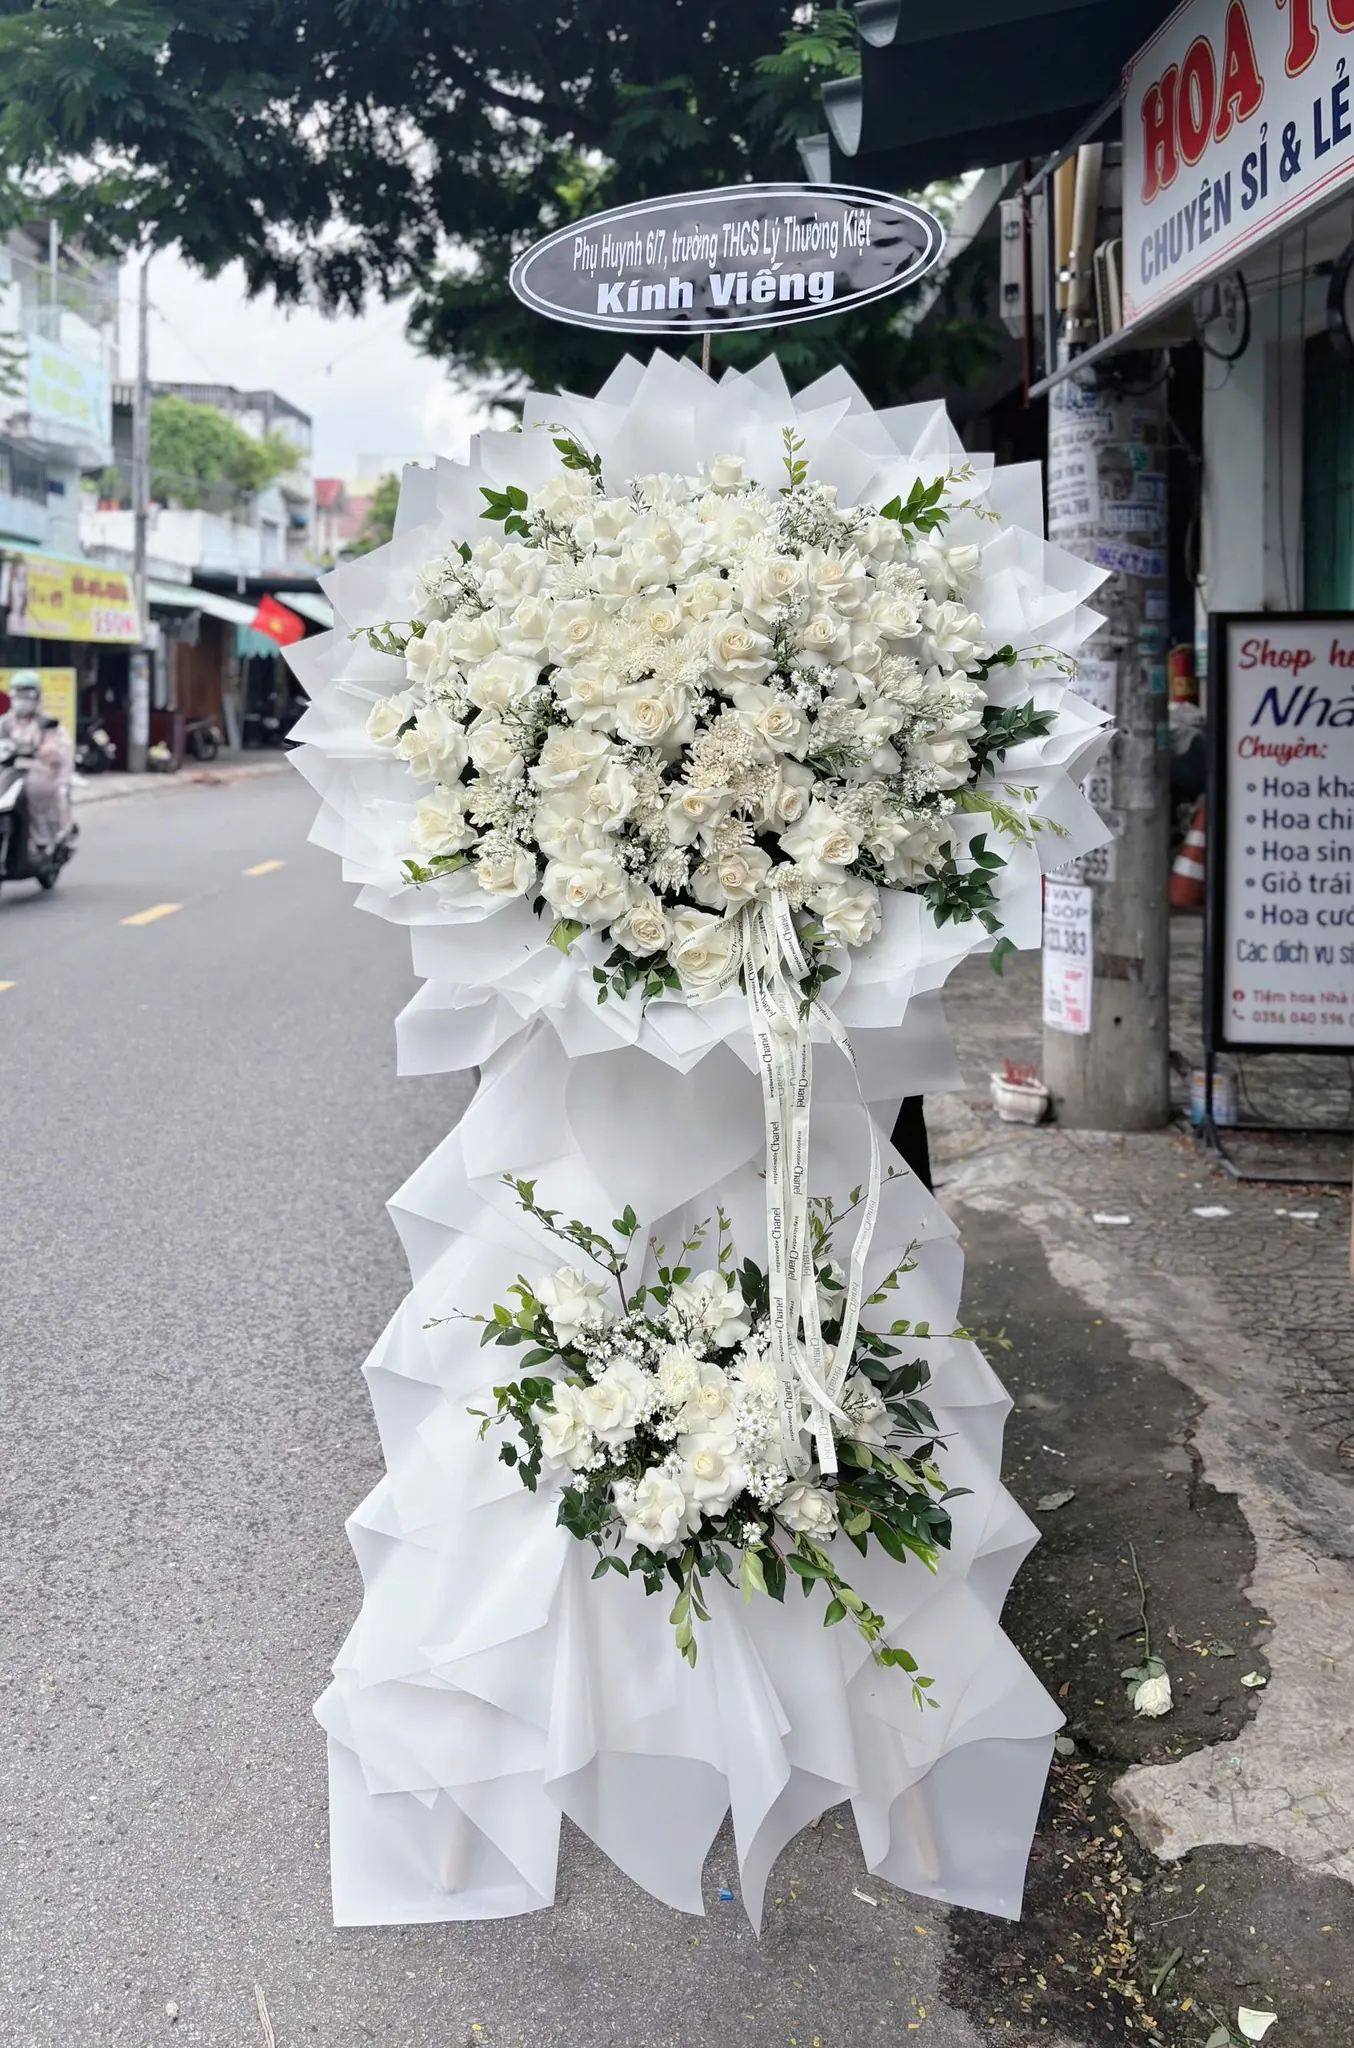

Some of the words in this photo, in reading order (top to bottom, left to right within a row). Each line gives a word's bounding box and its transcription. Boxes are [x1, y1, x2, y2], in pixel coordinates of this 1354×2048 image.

[1141, 0, 1264, 205] HOA
[1141, 171, 1231, 285] CHUYÊN
[1241, 122, 1268, 211] SỈ
[1280, 121, 1301, 182] &
[1314, 57, 1352, 160] LẺ
[573, 235, 599, 278] Phụ
[601, 231, 642, 277] Huynh
[646, 228, 668, 270] 6/7,
[672, 223, 718, 268] trường
[722, 219, 760, 258] THCS
[763, 216, 781, 264] Lý
[784, 211, 839, 259] Thường
[843, 208, 872, 257] Kiệt
[597, 276, 694, 314] Kính
[709, 262, 835, 307] Viếng
[1239, 638, 1316, 677] Shop
[1239, 735, 1327, 767] Chuyên:
[1262, 776, 1310, 798] Hoa
[1262, 808, 1310, 830] Hoa
[1262, 840, 1309, 862] Hoa
[1261, 870, 1302, 894] Giỏ
[1309, 872, 1351, 894] trái
[779, 913, 793, 942] Chanel
[1261, 903, 1309, 925] Hoa
[746, 951, 758, 982] Chanel
[1237, 938, 1268, 963] Các
[1314, 945, 1334, 967] vụ
[758, 1032, 773, 1063] Chanel
[796, 1078, 808, 1108] Chanel
[770, 1121, 780, 1152] Chanel
[793, 1165, 804, 1195] Chanel
[771, 1207, 782, 1240] Chanel
[788, 1249, 799, 1281] Chanel
[774, 1296, 784, 1329] Chanel
[782, 1380, 794, 1410] Chanel
